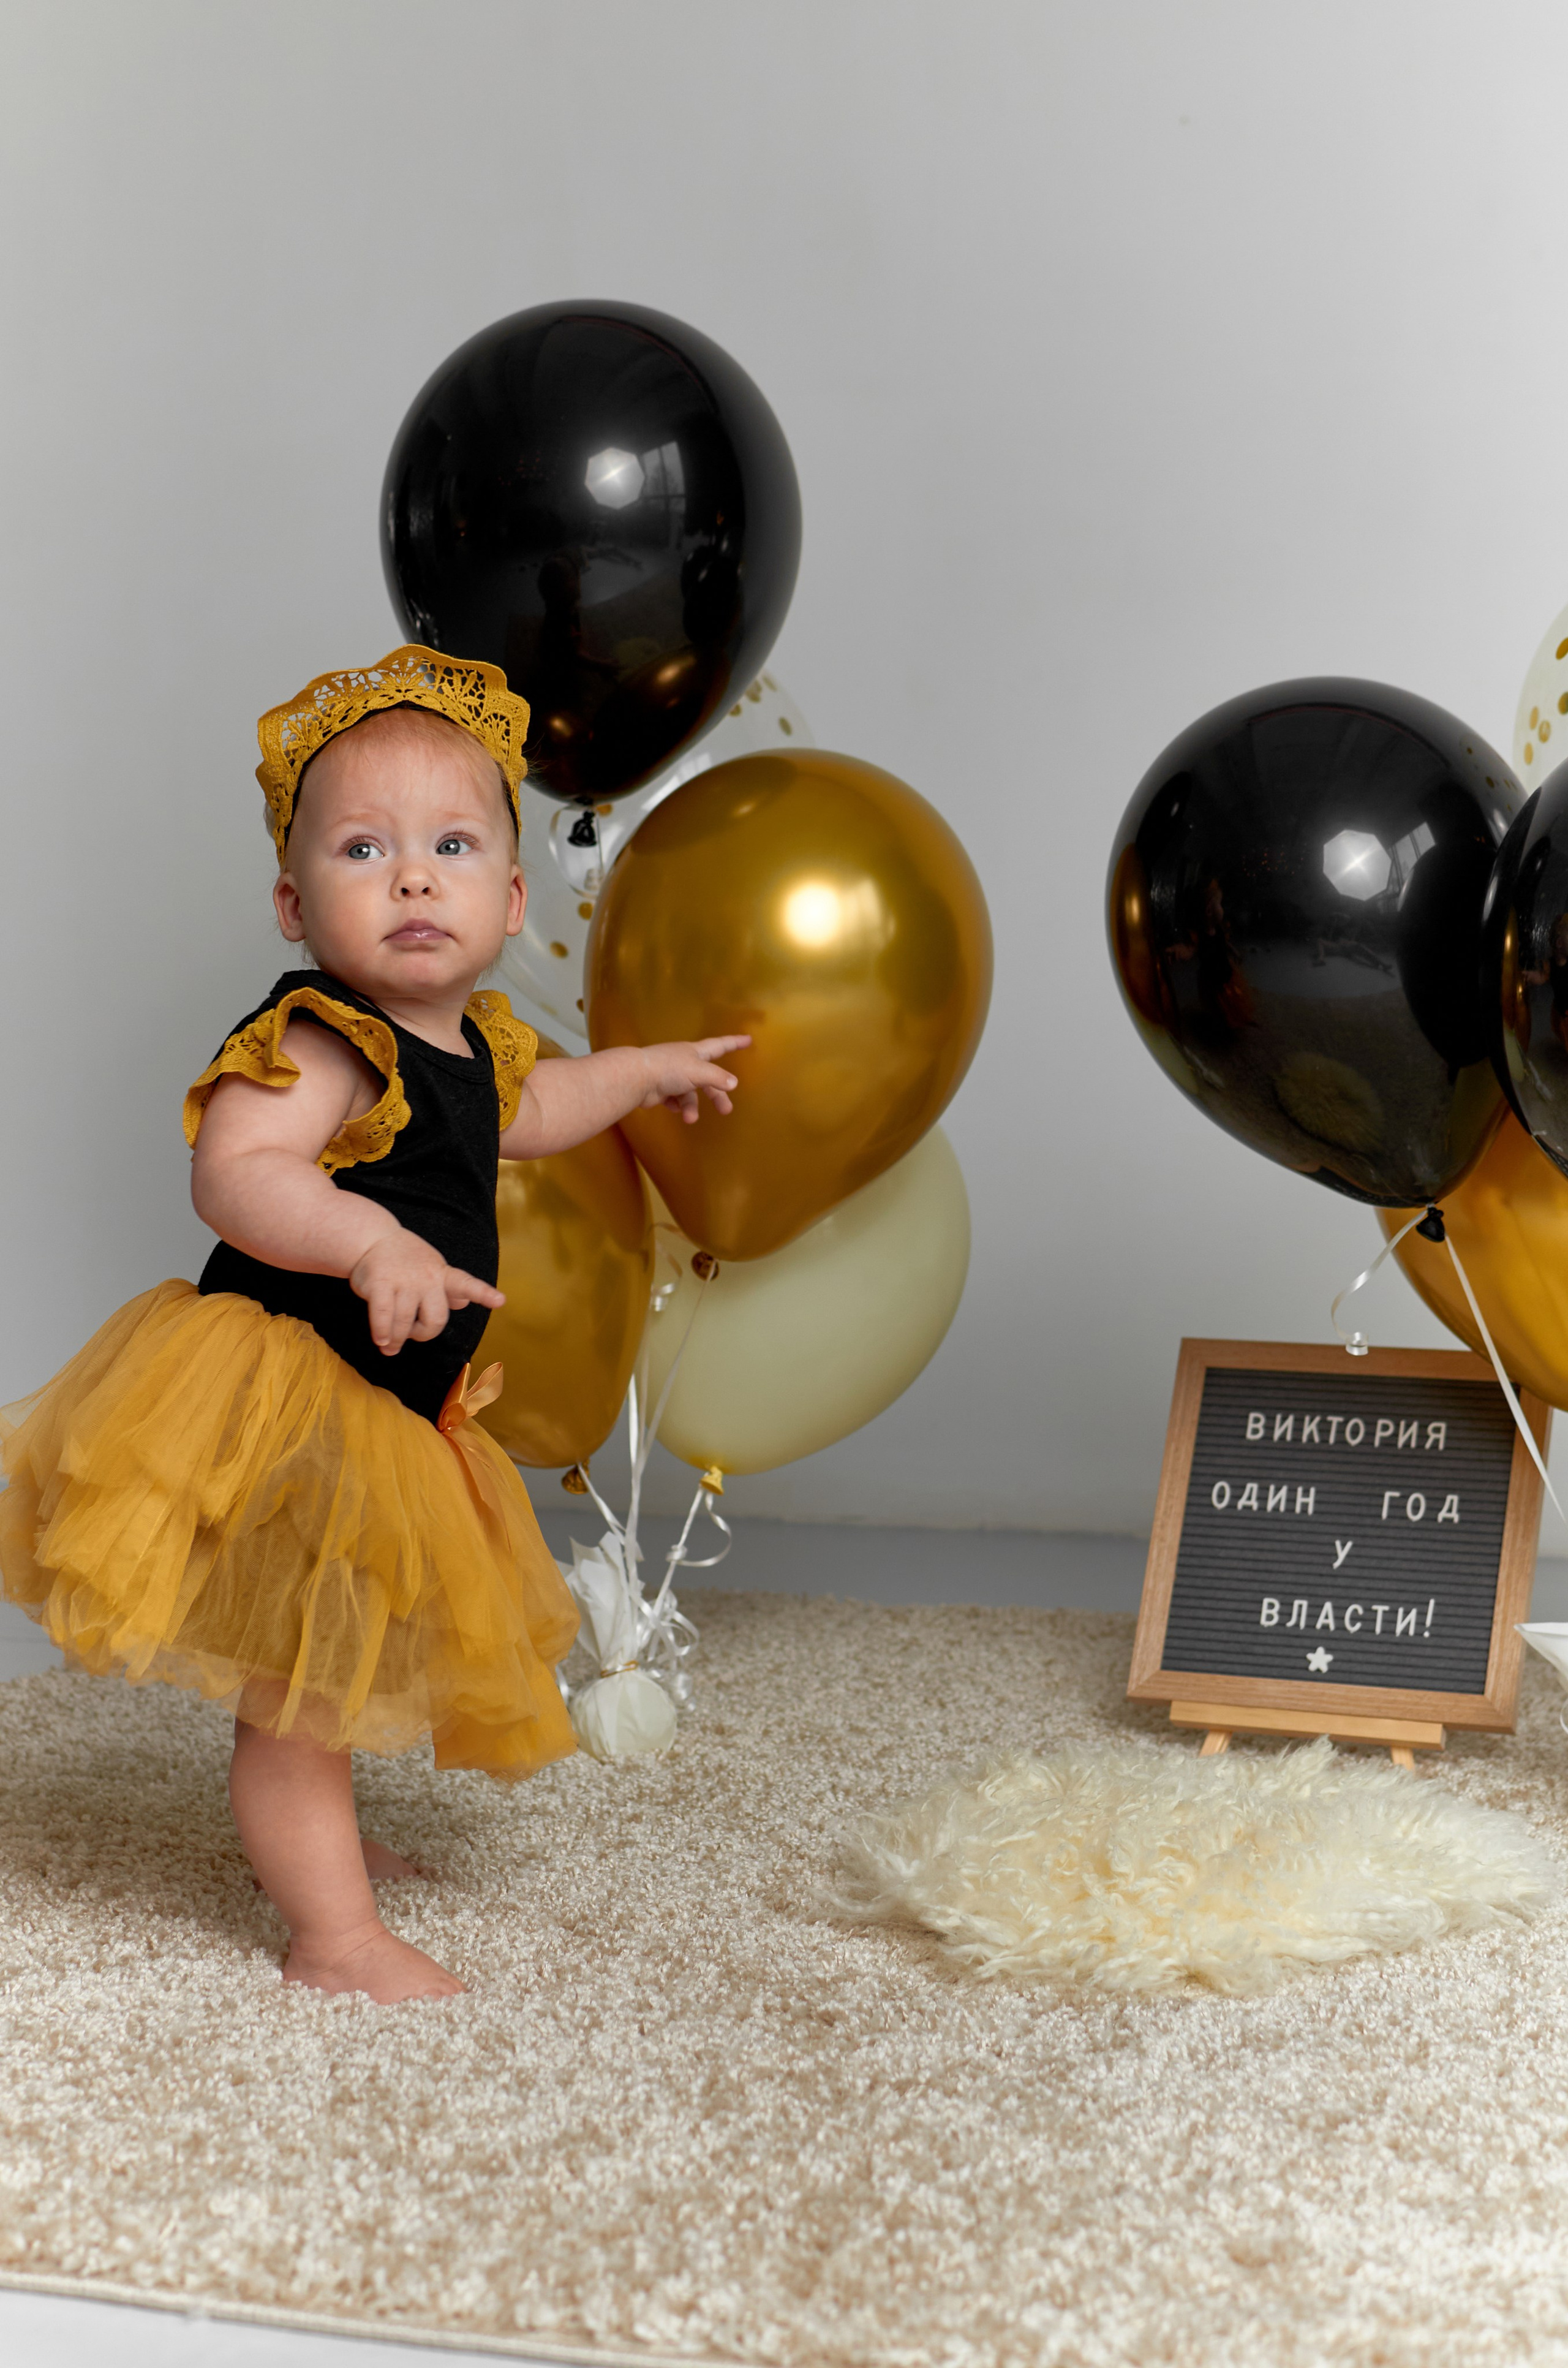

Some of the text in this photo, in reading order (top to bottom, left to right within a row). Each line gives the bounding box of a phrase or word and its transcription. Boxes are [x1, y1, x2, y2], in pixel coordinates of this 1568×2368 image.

[1246, 1412, 1446, 1450] ВИКТОРИЯ
[1211, 1480, 1460, 1524] ОДИН ГОД
[1332, 1539, 1354, 1570] У
[1259, 1597, 1436, 1638] ВЛАСТИ!
